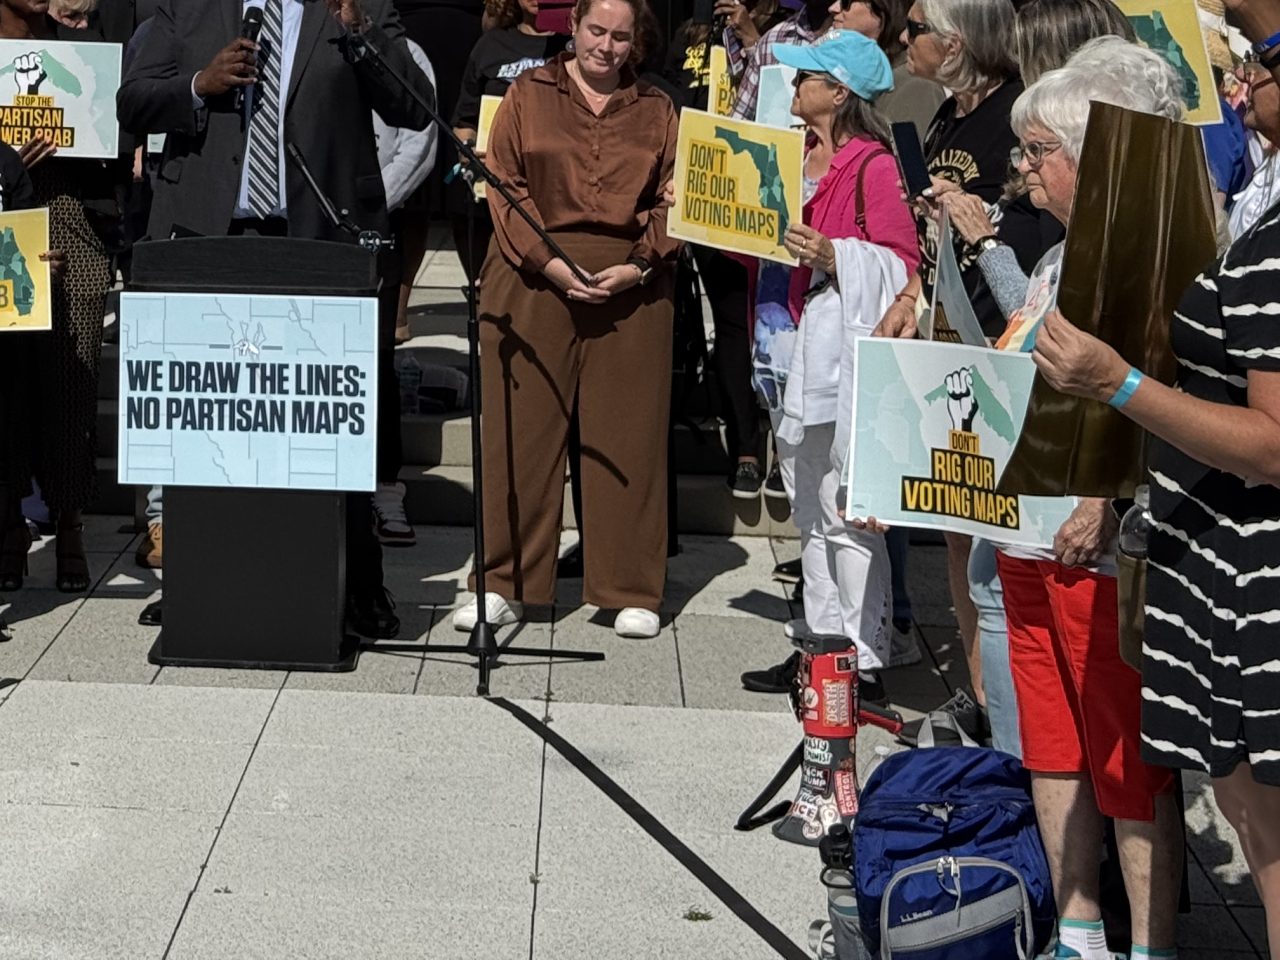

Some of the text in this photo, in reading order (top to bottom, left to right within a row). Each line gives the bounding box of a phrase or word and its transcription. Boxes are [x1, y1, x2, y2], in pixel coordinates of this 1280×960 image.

[16, 96, 53, 107] STOP THE
[689, 143, 727, 174] DON'T
[686, 169, 735, 202] RIG OUR
[685, 195, 775, 238] VOTING MAPS
[126, 359, 366, 397] WE DRAW THE LINES:
[126, 396, 365, 436] NO PARTISAN MAPS
[951, 432, 977, 454] DON'T
[933, 450, 994, 491] RIG OUR
[904, 480, 1018, 528] VOTING MAPS
